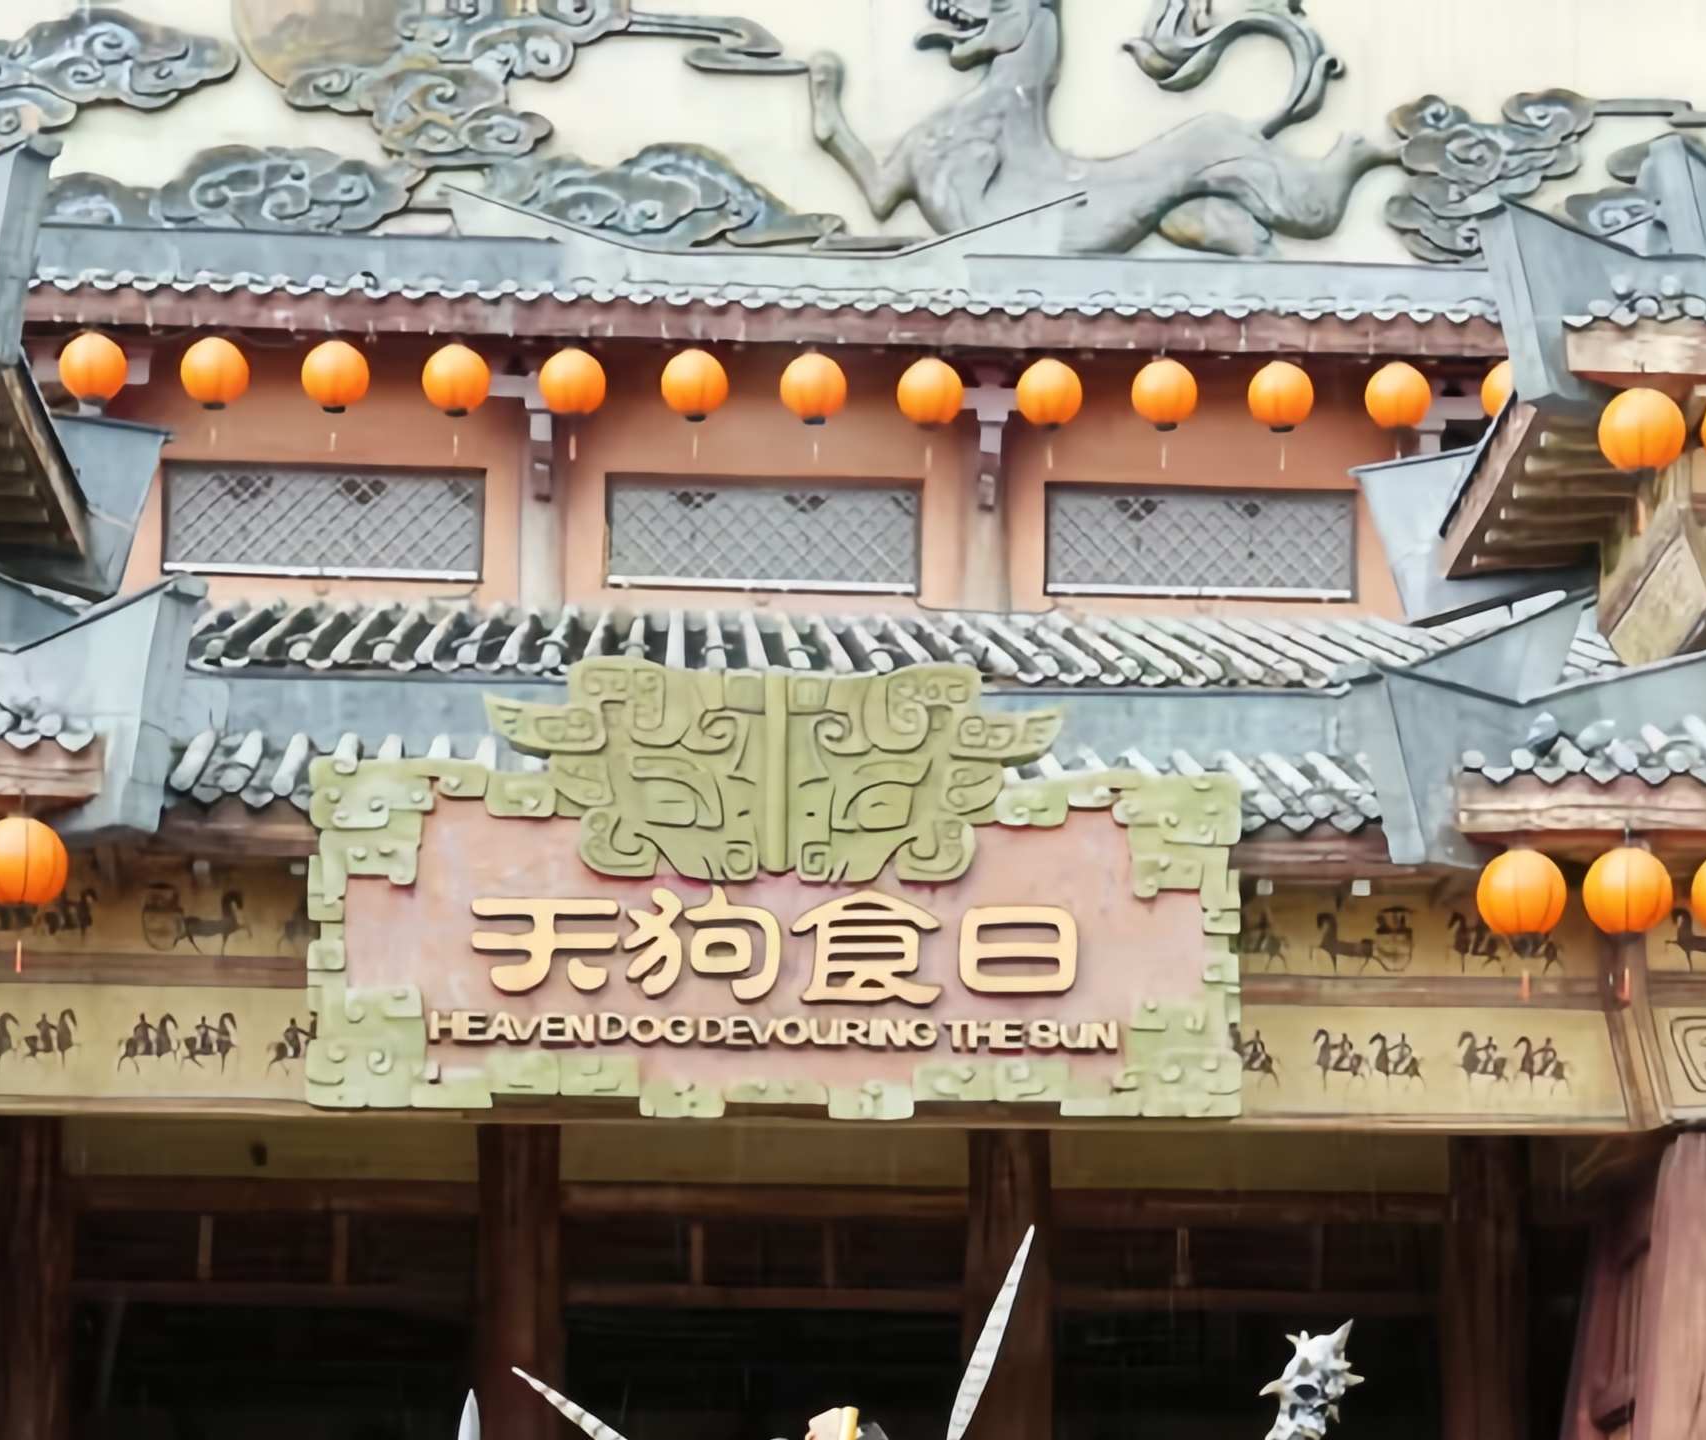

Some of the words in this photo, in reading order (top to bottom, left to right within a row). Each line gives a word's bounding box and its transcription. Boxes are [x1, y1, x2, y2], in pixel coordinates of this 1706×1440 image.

[471, 885, 1078, 1004] 天狗食日
[429, 1010, 595, 1043] HEAVEN
[598, 1013, 694, 1045] DOG
[697, 1014, 938, 1048] DEVOURING
[945, 1019, 1024, 1050] THE
[1028, 1019, 1119, 1051] SUN
